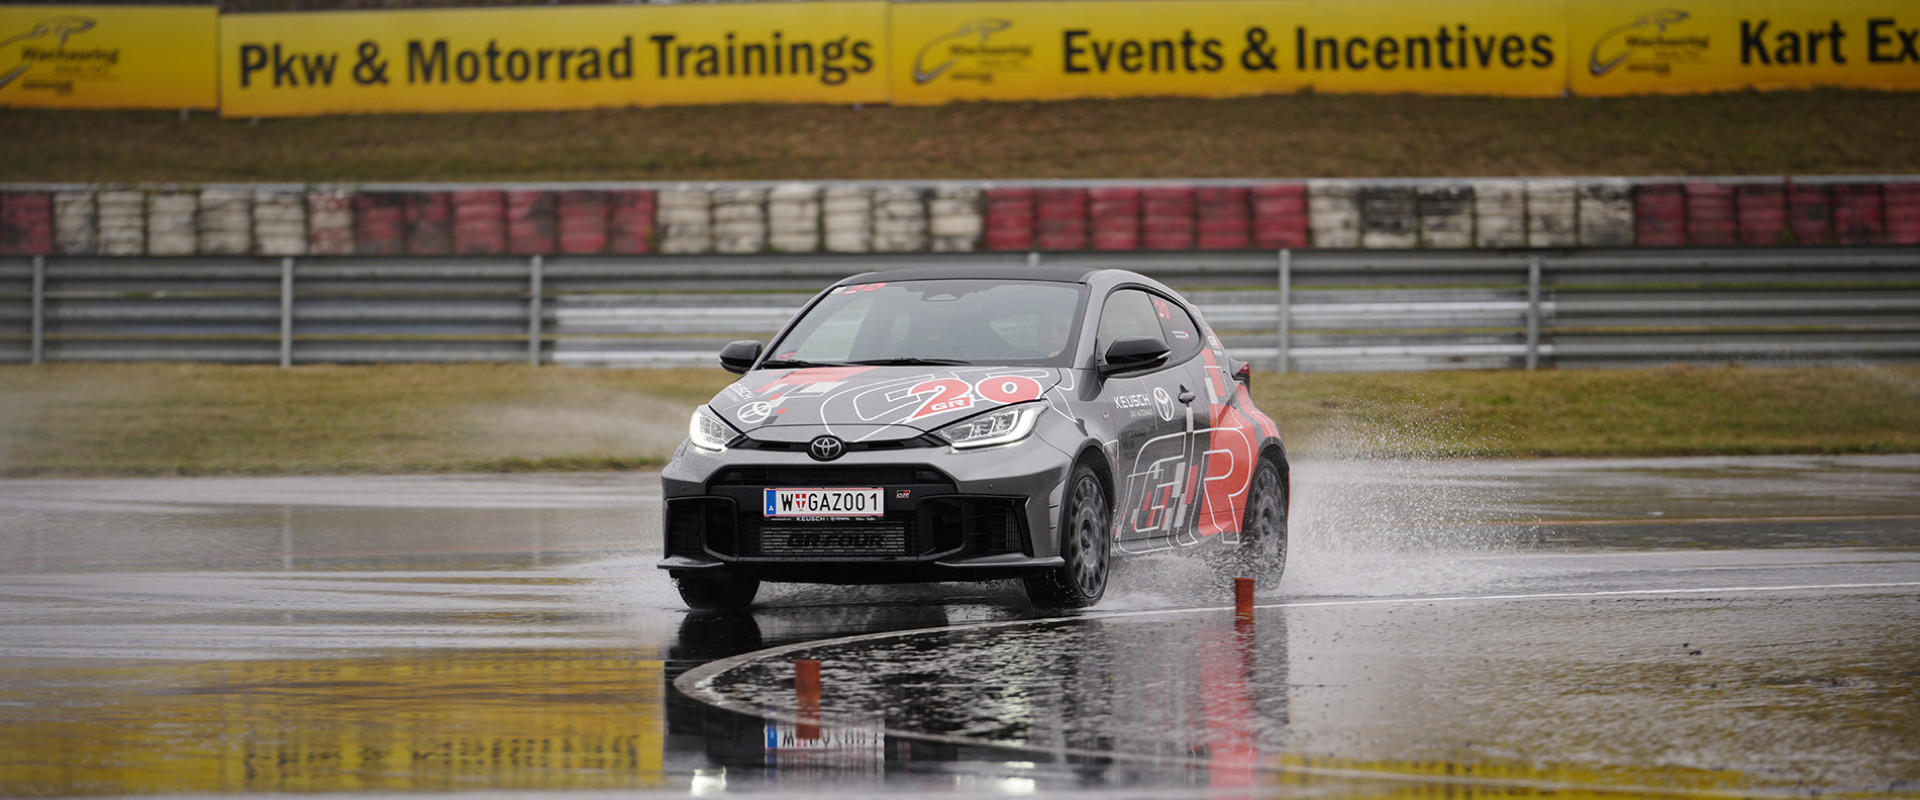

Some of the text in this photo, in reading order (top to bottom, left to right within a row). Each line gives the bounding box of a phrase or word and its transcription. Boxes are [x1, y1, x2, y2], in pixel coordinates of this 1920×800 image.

[239, 31, 874, 88] Pkw & Motorrad Trainings
[1062, 23, 1554, 73] Events & Incentives
[1741, 20, 1847, 65] Kart
[907, 375, 1043, 424] 20
[931, 399, 966, 411] GR
[1113, 393, 1152, 409] KEUSCH
[781, 493, 793, 511] W
